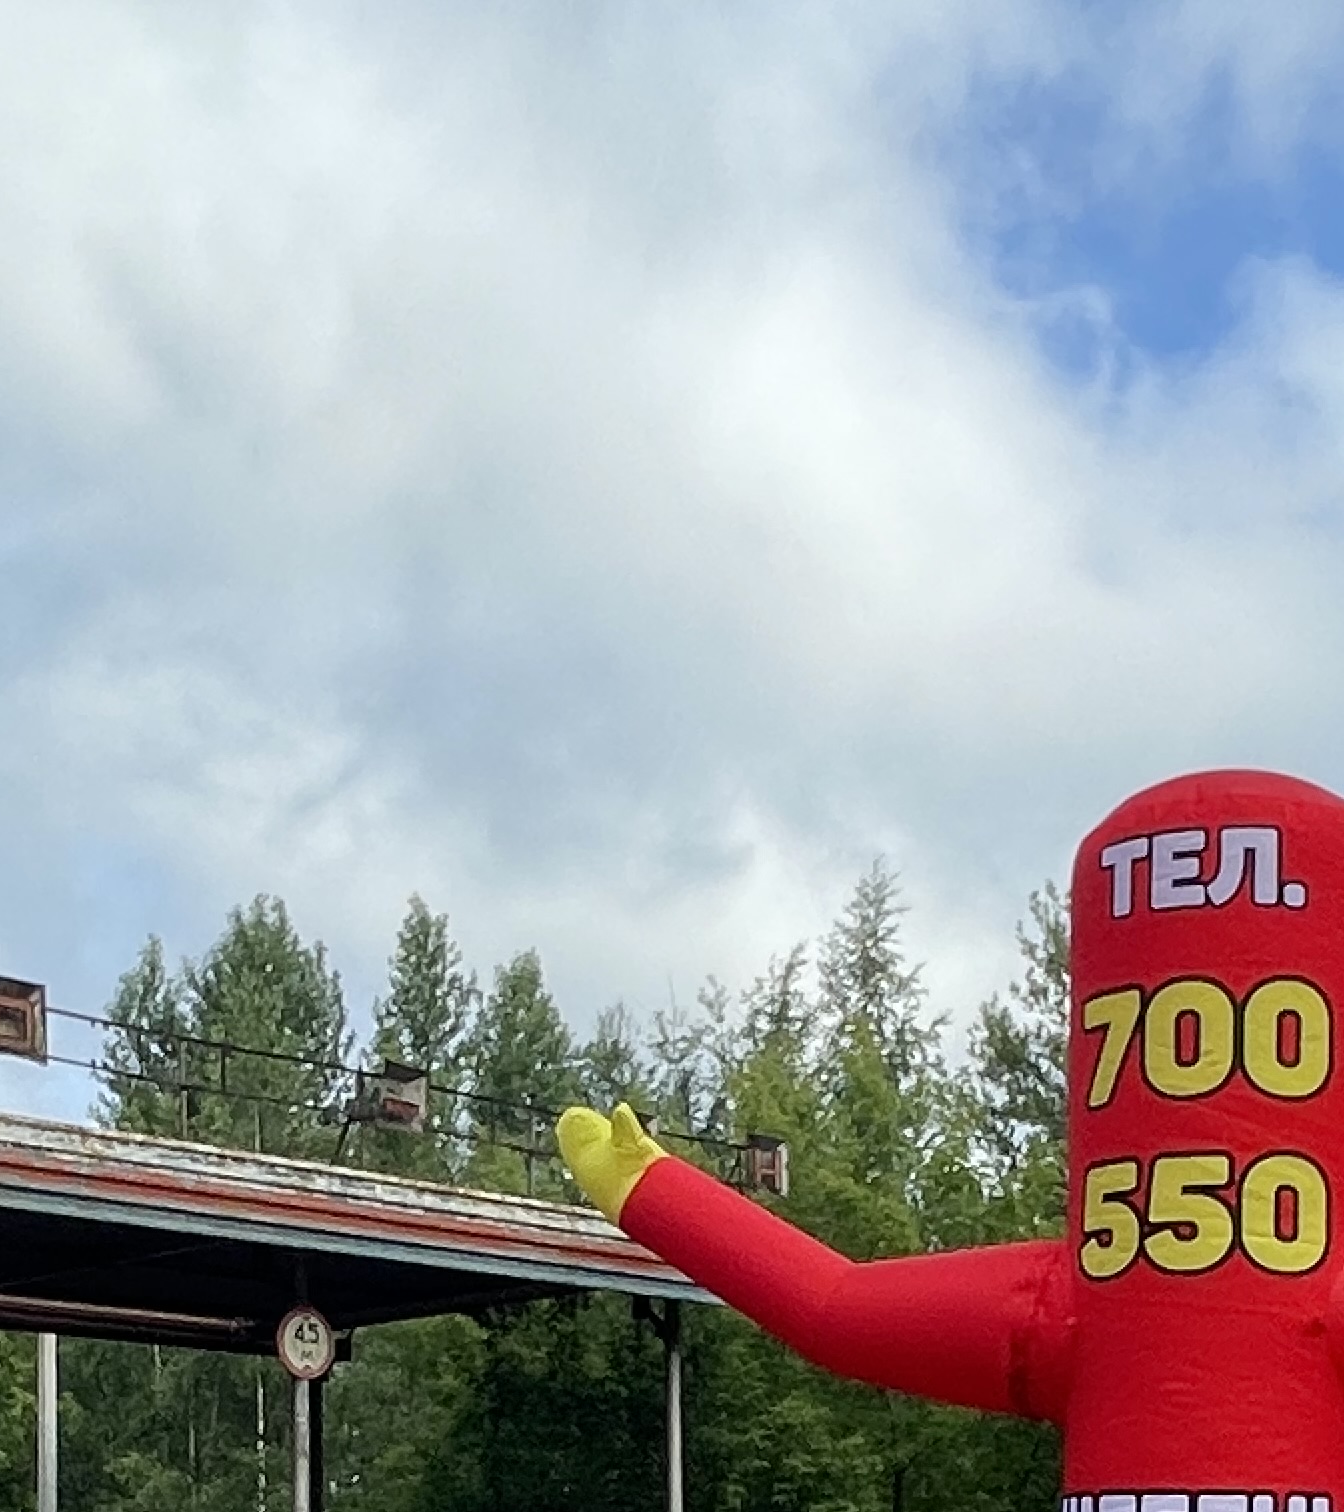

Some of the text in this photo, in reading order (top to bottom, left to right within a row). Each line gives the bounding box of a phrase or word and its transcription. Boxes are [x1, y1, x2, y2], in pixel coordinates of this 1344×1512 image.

[1099, 826, 1307, 918] ТЕЛ.
[1082, 976, 1332, 1110] 700
[1079, 1152, 1330, 1280] 550
